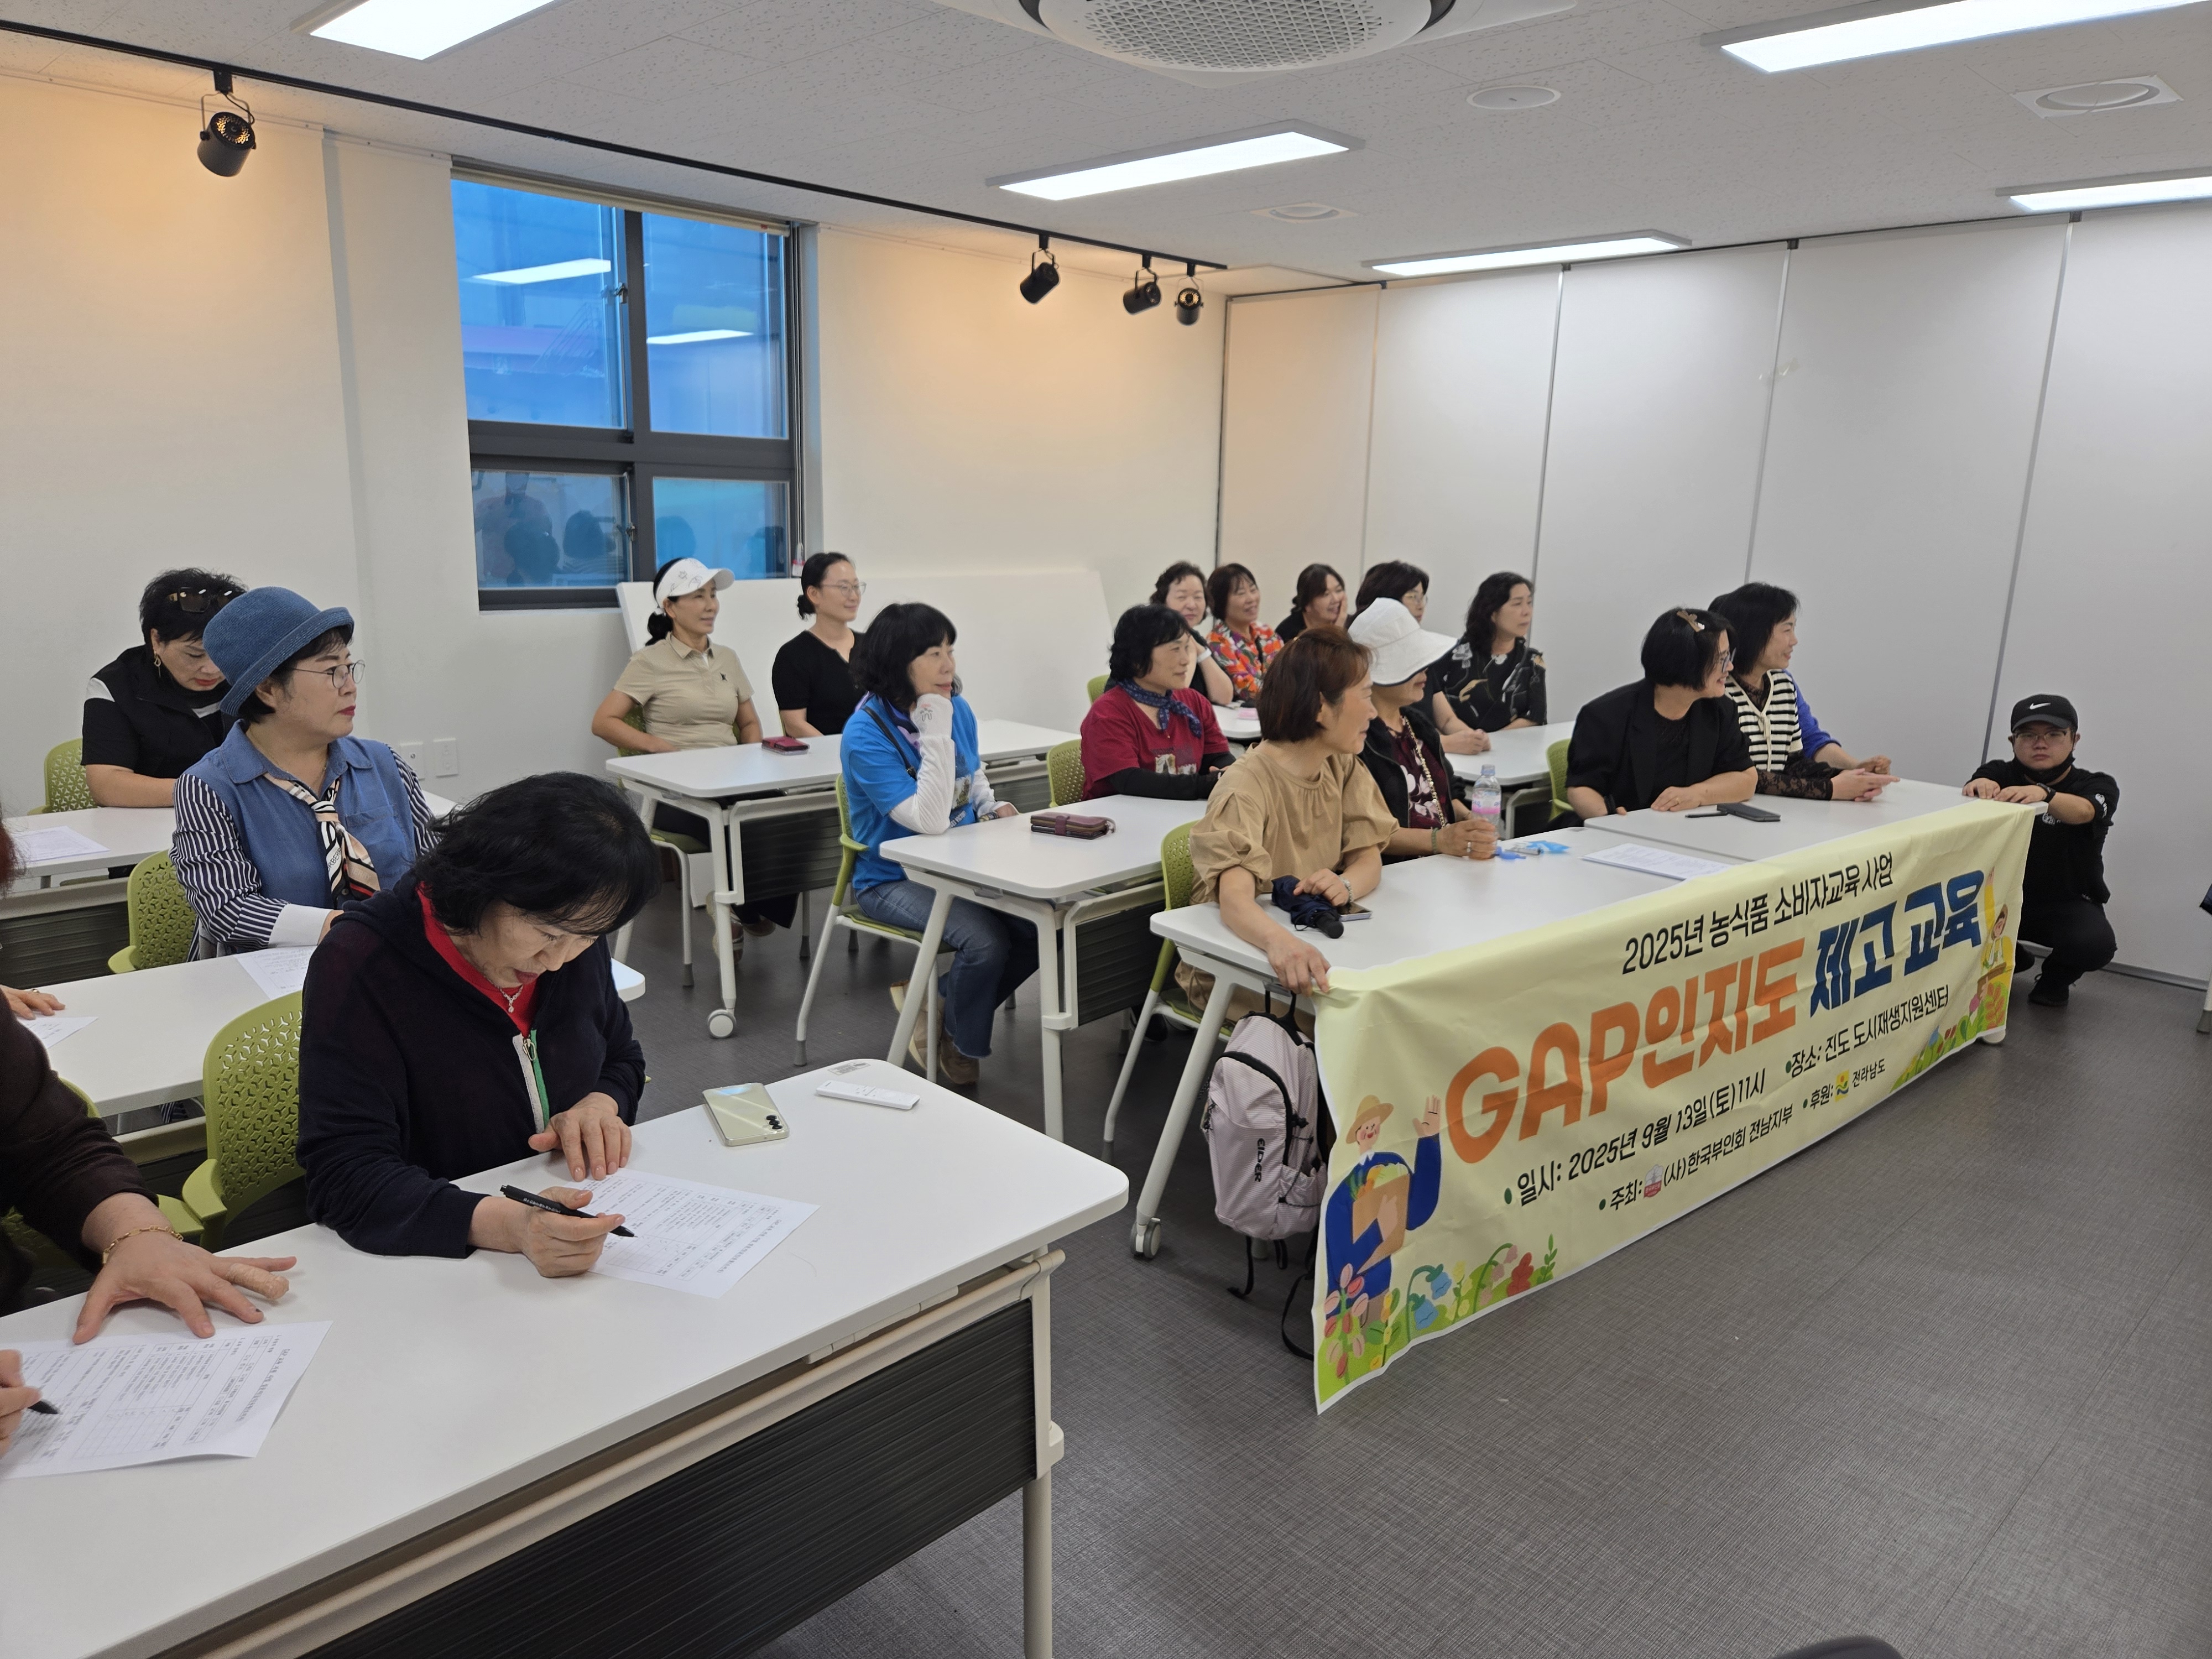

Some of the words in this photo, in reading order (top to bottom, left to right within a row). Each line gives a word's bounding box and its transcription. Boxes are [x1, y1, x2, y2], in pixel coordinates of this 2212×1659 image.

[1623, 914, 1704, 974] 2025년
[1709, 893, 1769, 948] 농식품
[1773, 864, 1861, 926] 소비자교육
[1862, 852, 1893, 892] 사업
[1446, 937, 1806, 1164] GAP인지도
[1810, 900, 1897, 1018] 제고
[1904, 870, 1984, 976] 교육
[1791, 1045, 1822, 1078] 장소:
[1825, 1027, 1850, 1062] 진도
[1854, 984, 1949, 1048] 도시재생지원센터
[1810, 1083, 1834, 1110] 후원:
[1852, 1058, 1886, 1088] 전라남도
[1254, 1138, 1265, 1182] EIDER
[1517, 1162, 1562, 1207] 일시:
[1568, 1128, 1637, 1181] 2025년
[1642, 1114, 1671, 1149] 9월
[1610, 1178, 1642, 1211] 주최:
[1749, 1103, 1793, 1143] 전남지부
